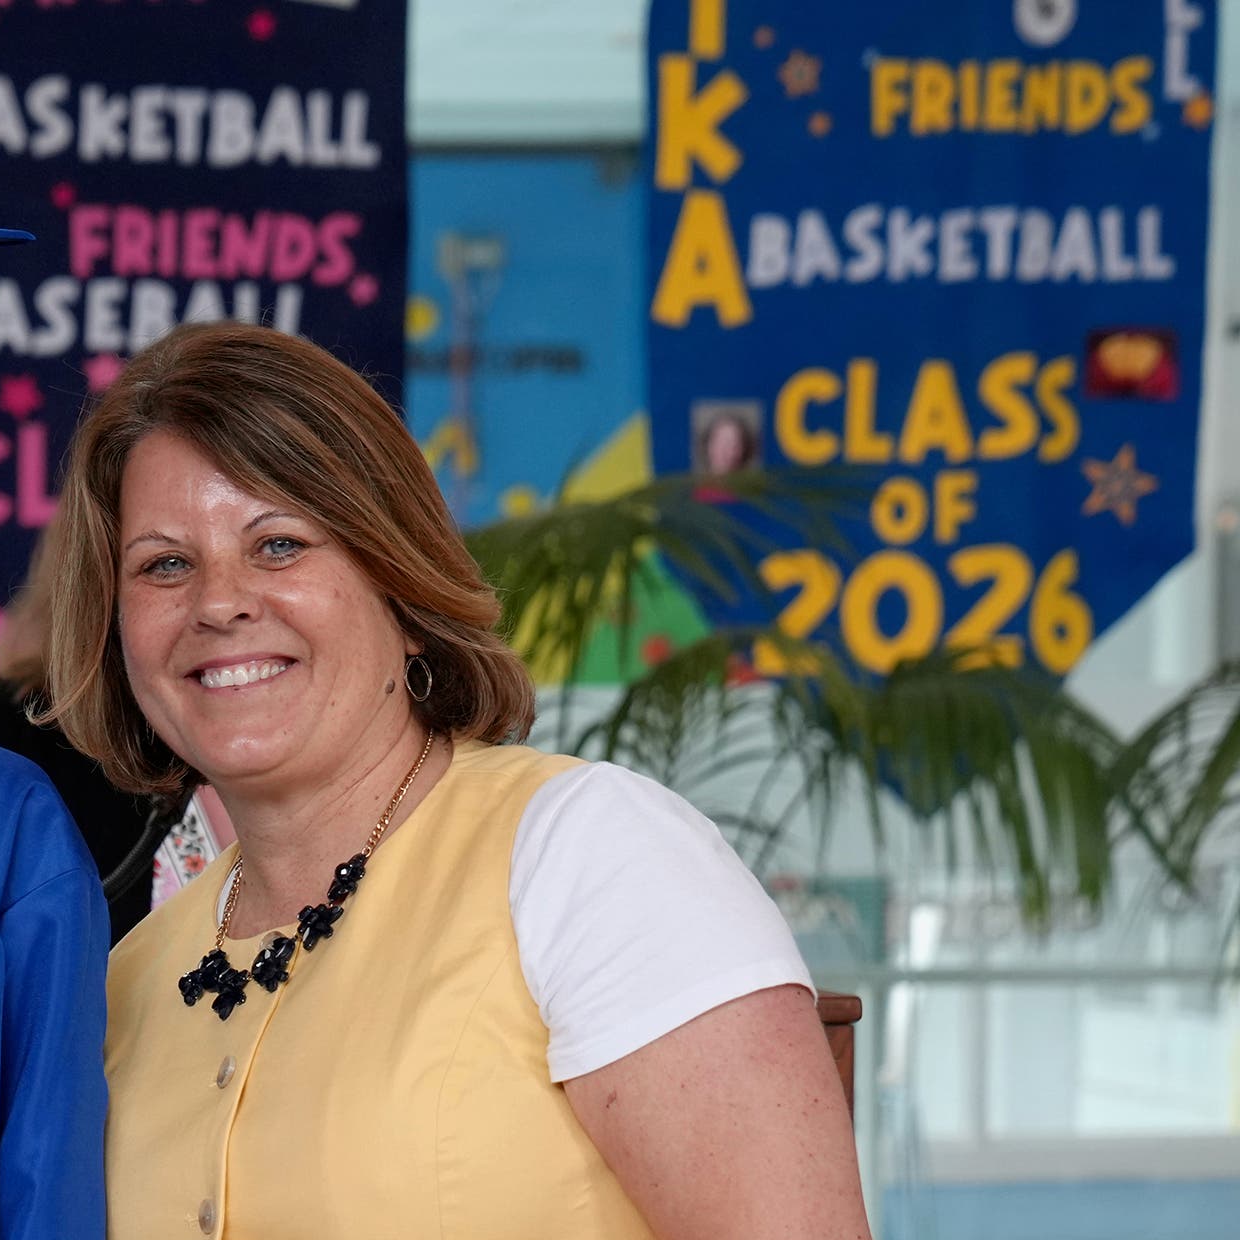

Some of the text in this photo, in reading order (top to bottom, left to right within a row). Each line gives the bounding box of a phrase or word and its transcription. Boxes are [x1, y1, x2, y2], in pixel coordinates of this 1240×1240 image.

[870, 56, 1153, 138] FRIENDS
[68, 206, 361, 286] FRIENDS
[746, 204, 1174, 288] BASKETBALL
[773, 352, 1081, 465] CLASS
[871, 470, 978, 545] OF
[752, 543, 1095, 676] 2026
